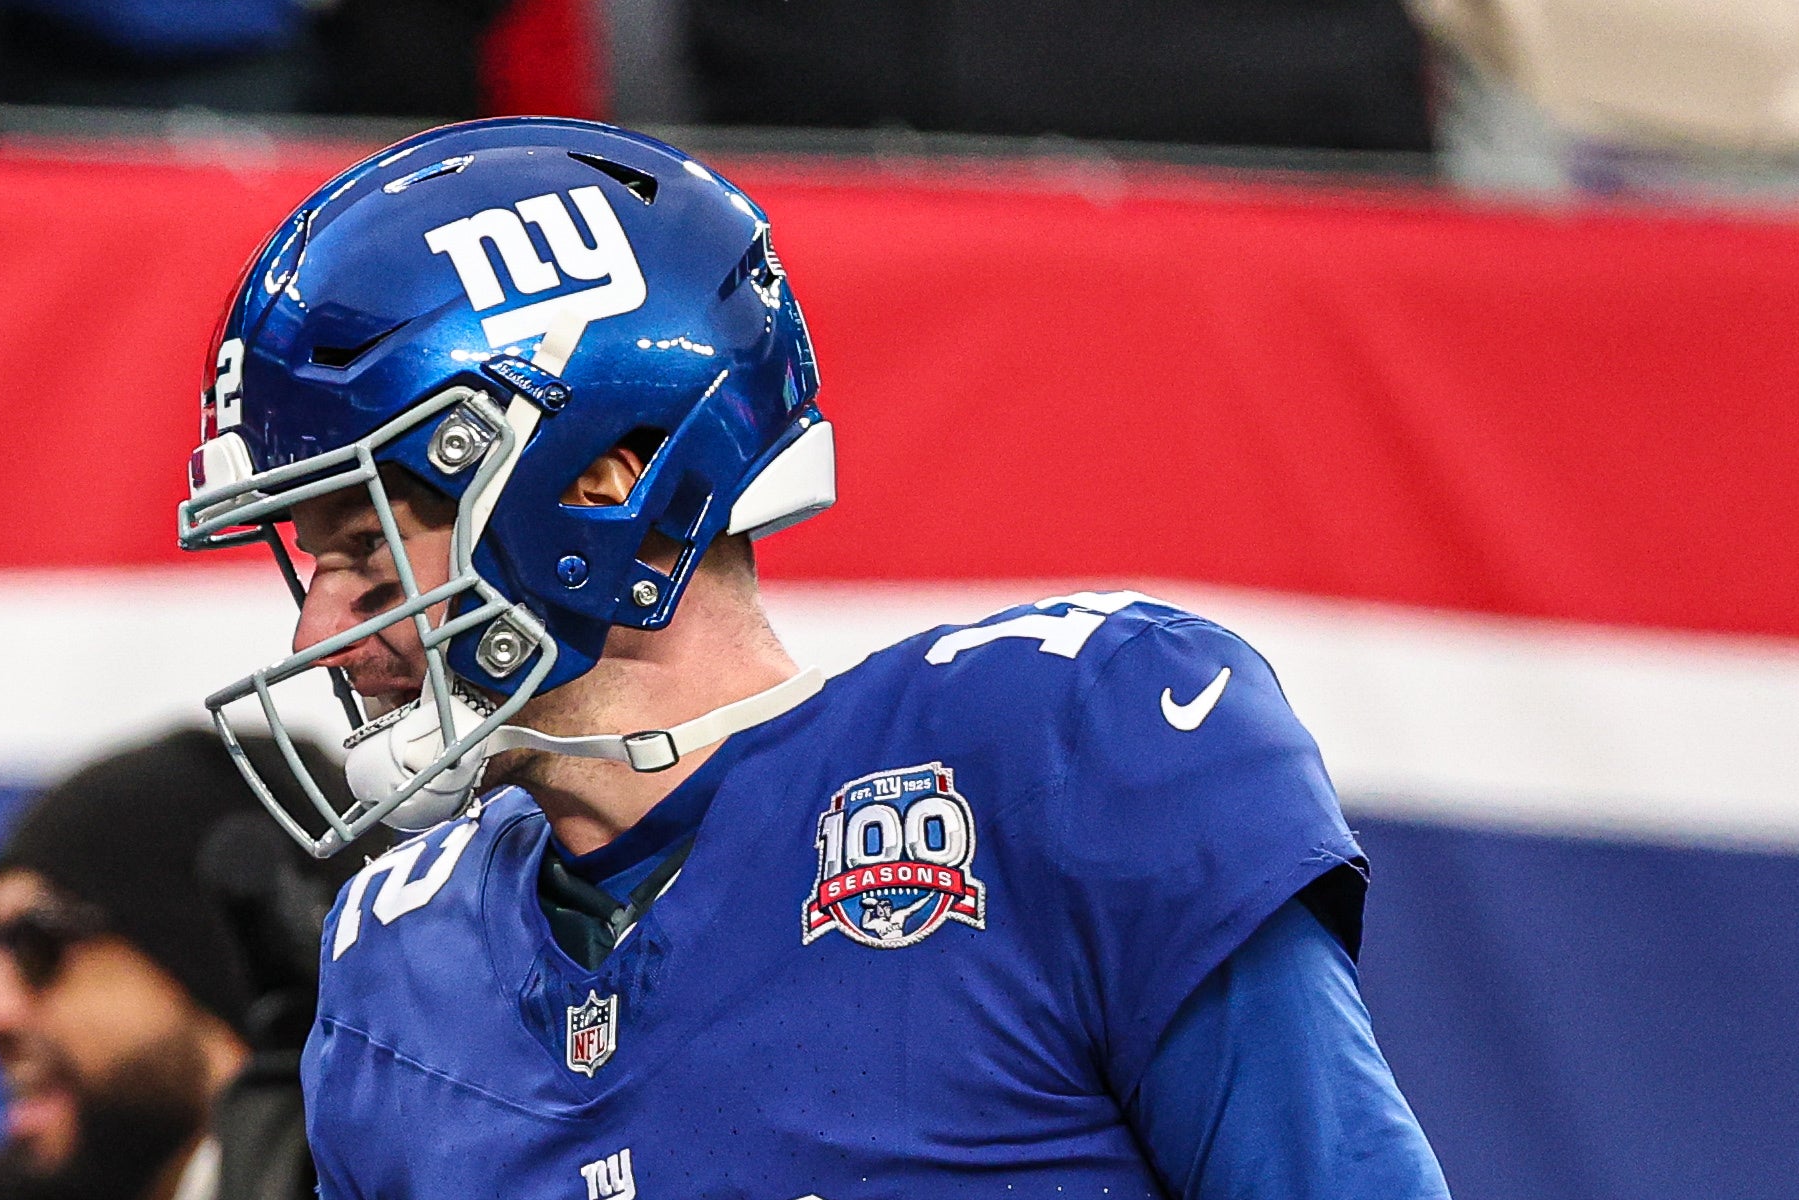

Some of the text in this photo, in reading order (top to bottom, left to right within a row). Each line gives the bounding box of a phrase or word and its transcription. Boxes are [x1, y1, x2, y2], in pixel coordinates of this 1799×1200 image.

[425, 185, 647, 347] ny
[850, 787, 872, 802] EST.
[903, 777, 932, 791] 1925
[820, 797, 968, 880] 100
[828, 866, 953, 897] SEASONS
[574, 1027, 605, 1060] NFL
